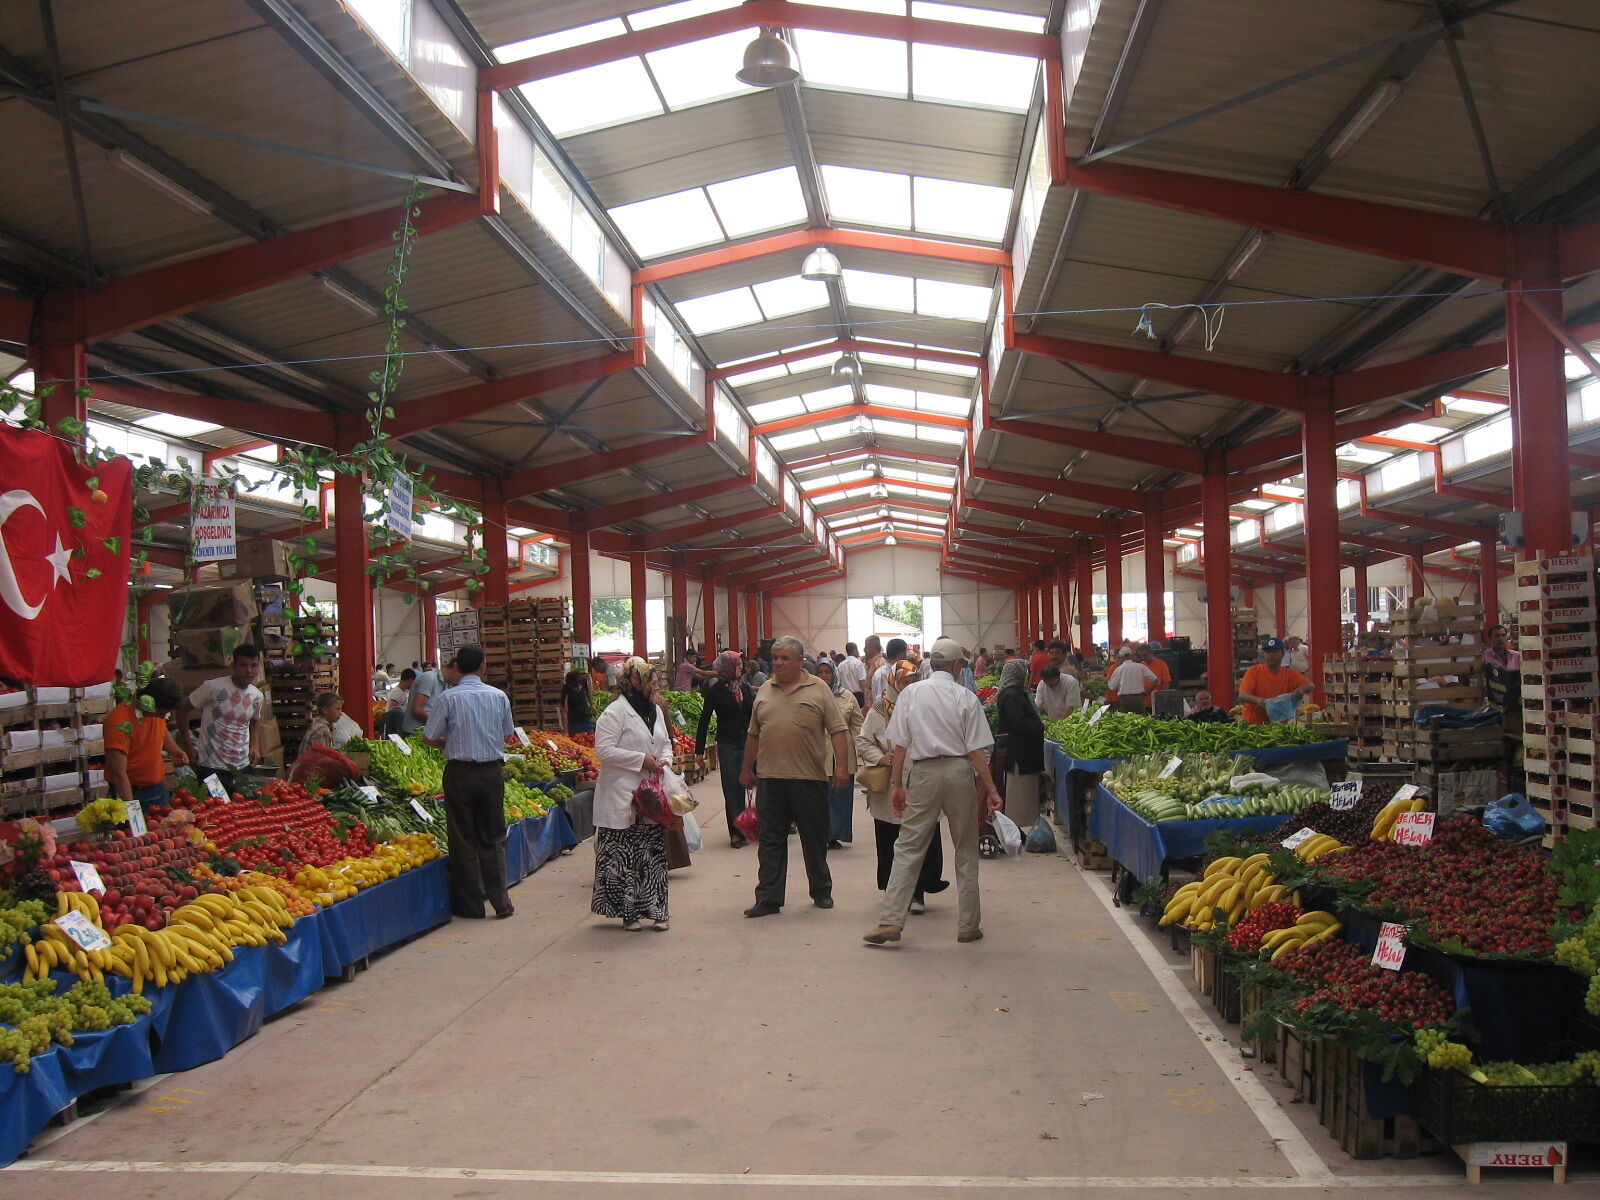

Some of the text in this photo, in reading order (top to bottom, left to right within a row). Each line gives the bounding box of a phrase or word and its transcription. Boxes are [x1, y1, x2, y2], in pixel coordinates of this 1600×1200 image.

[1395, 812, 1432, 825] YEMEK
[1395, 827, 1431, 846] HELAL
[1489, 1153, 1544, 1166] BERY
